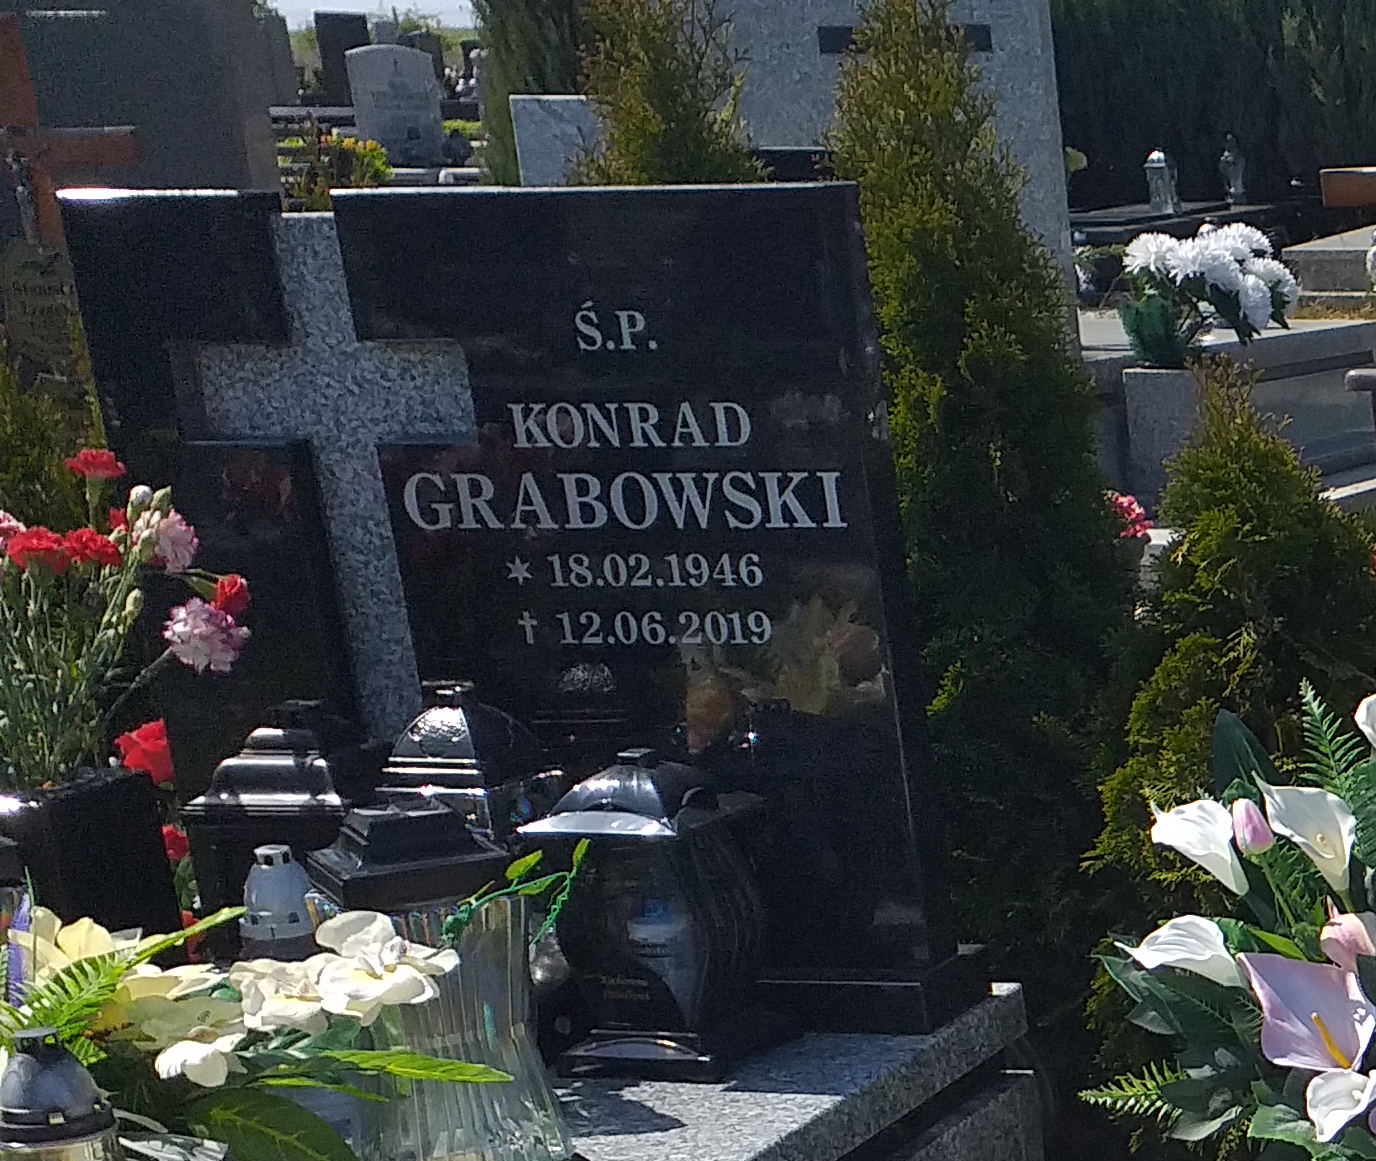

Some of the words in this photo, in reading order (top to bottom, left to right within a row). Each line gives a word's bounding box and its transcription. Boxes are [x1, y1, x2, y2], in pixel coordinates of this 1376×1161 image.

[575, 301, 658, 350] Ś.P.
[508, 402, 752, 448] KONRAD
[404, 472, 848, 530] GRABOWSKI
[548, 554, 764, 587] 18.02.1946
[557, 611, 773, 645] 12.06.2019
